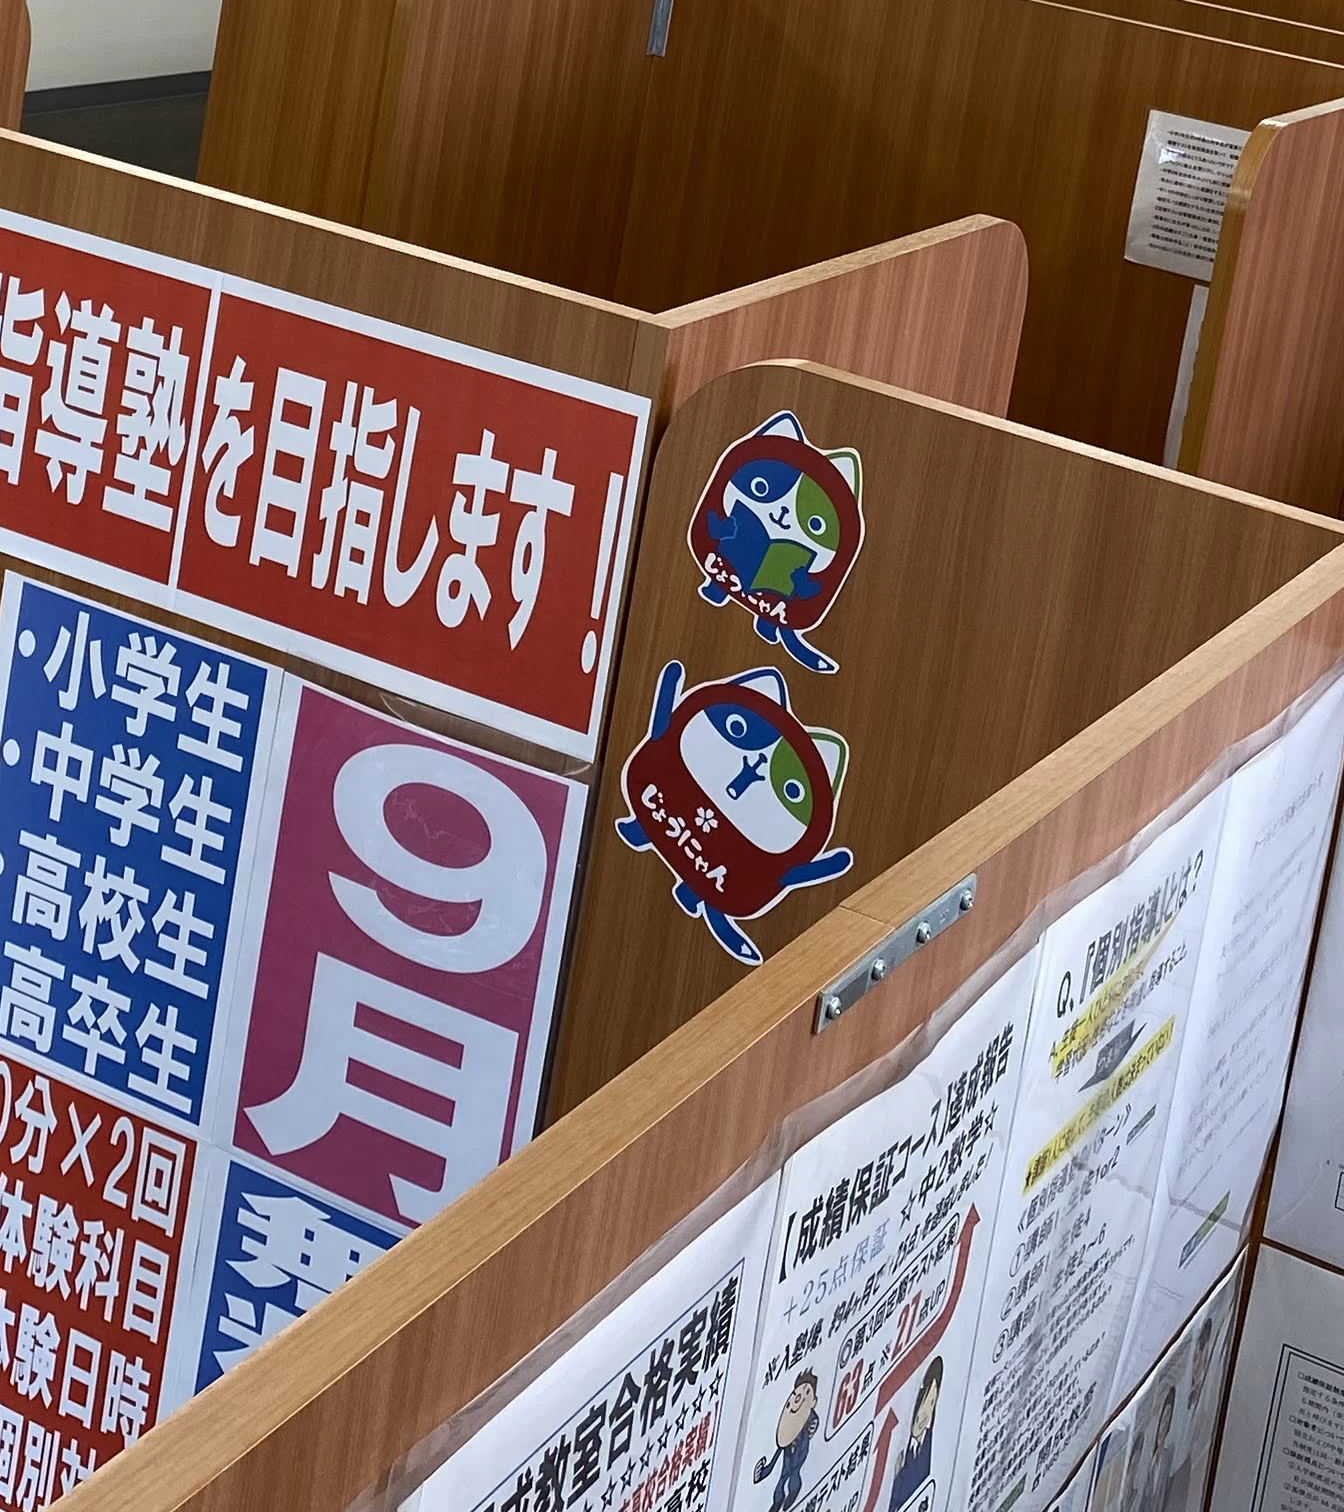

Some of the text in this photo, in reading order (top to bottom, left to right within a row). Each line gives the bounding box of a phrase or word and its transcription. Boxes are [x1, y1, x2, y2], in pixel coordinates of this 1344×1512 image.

[243, 741, 548, 1224] 9月
[640, 783, 727, 894] じょうにゃん
